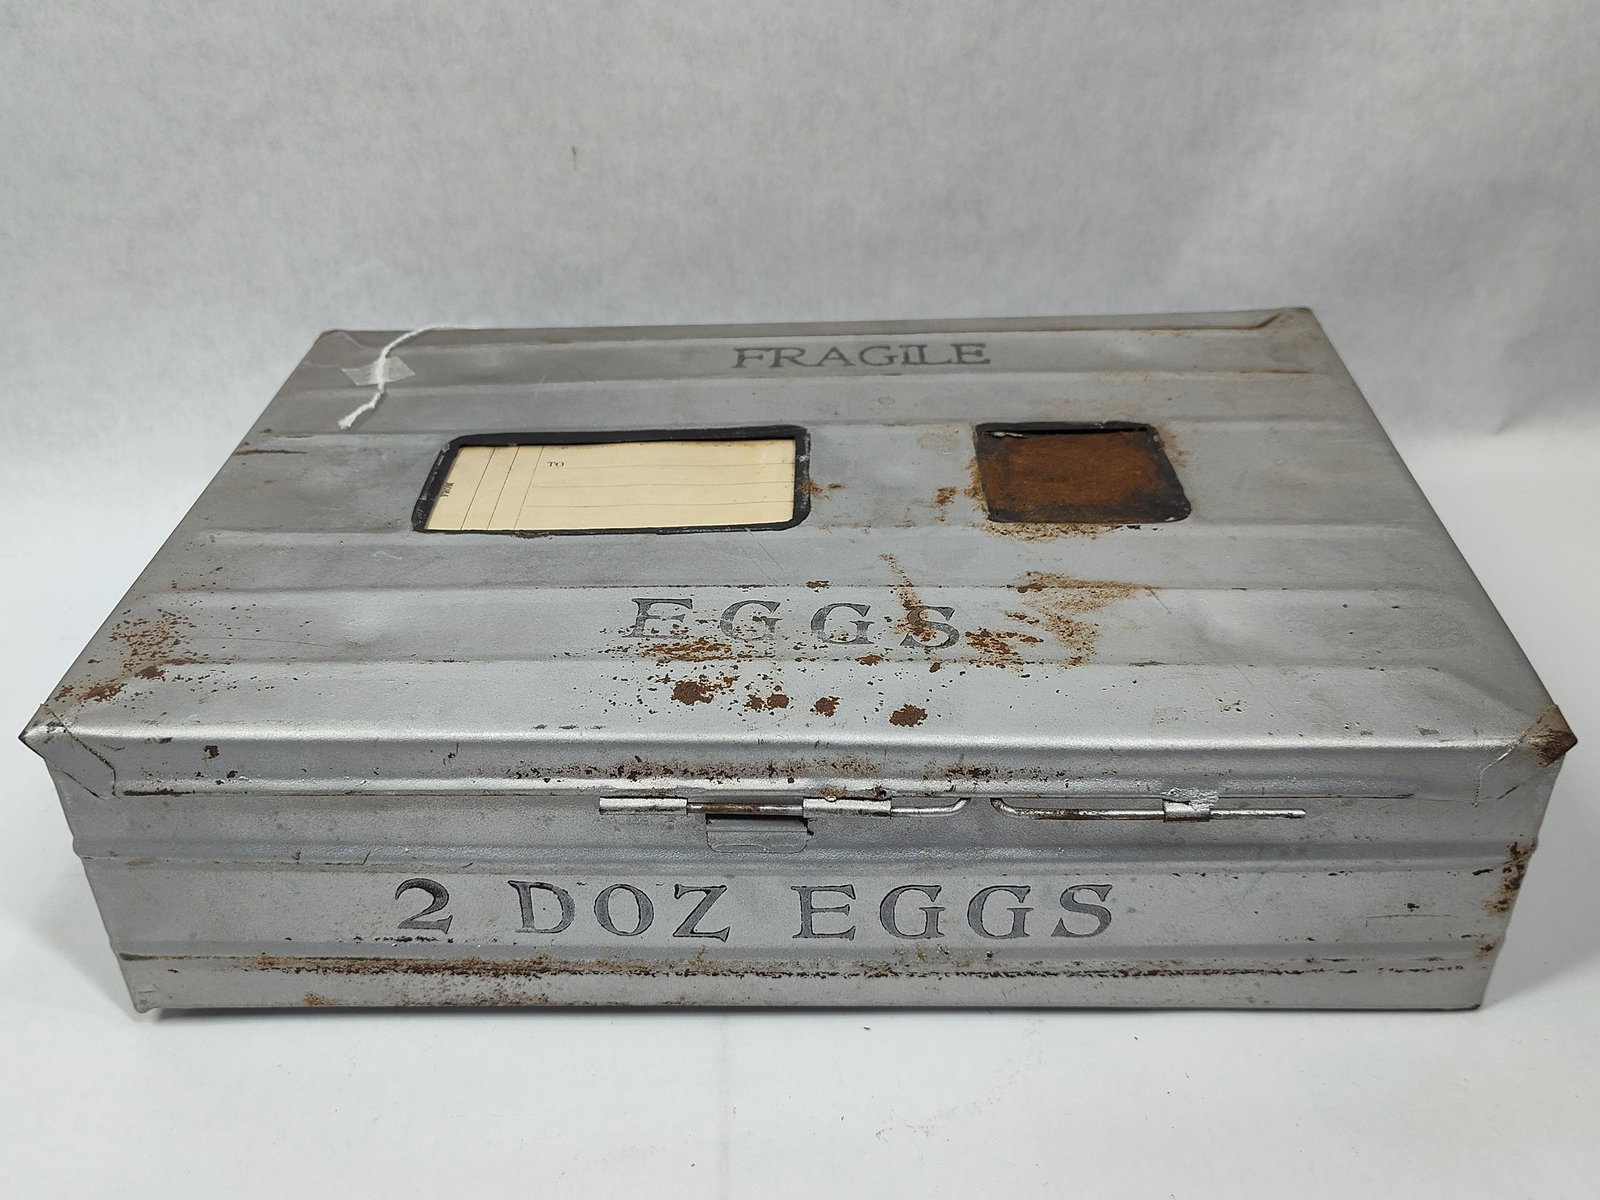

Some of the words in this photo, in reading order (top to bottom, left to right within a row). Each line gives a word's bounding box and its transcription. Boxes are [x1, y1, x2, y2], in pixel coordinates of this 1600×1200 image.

[731, 342, 991, 369] FRAGILE
[621, 597, 959, 648] EGGS
[394, 877, 454, 935] 2
[507, 879, 731, 943] DOZ
[790, 884, 1113, 941] EGGS
